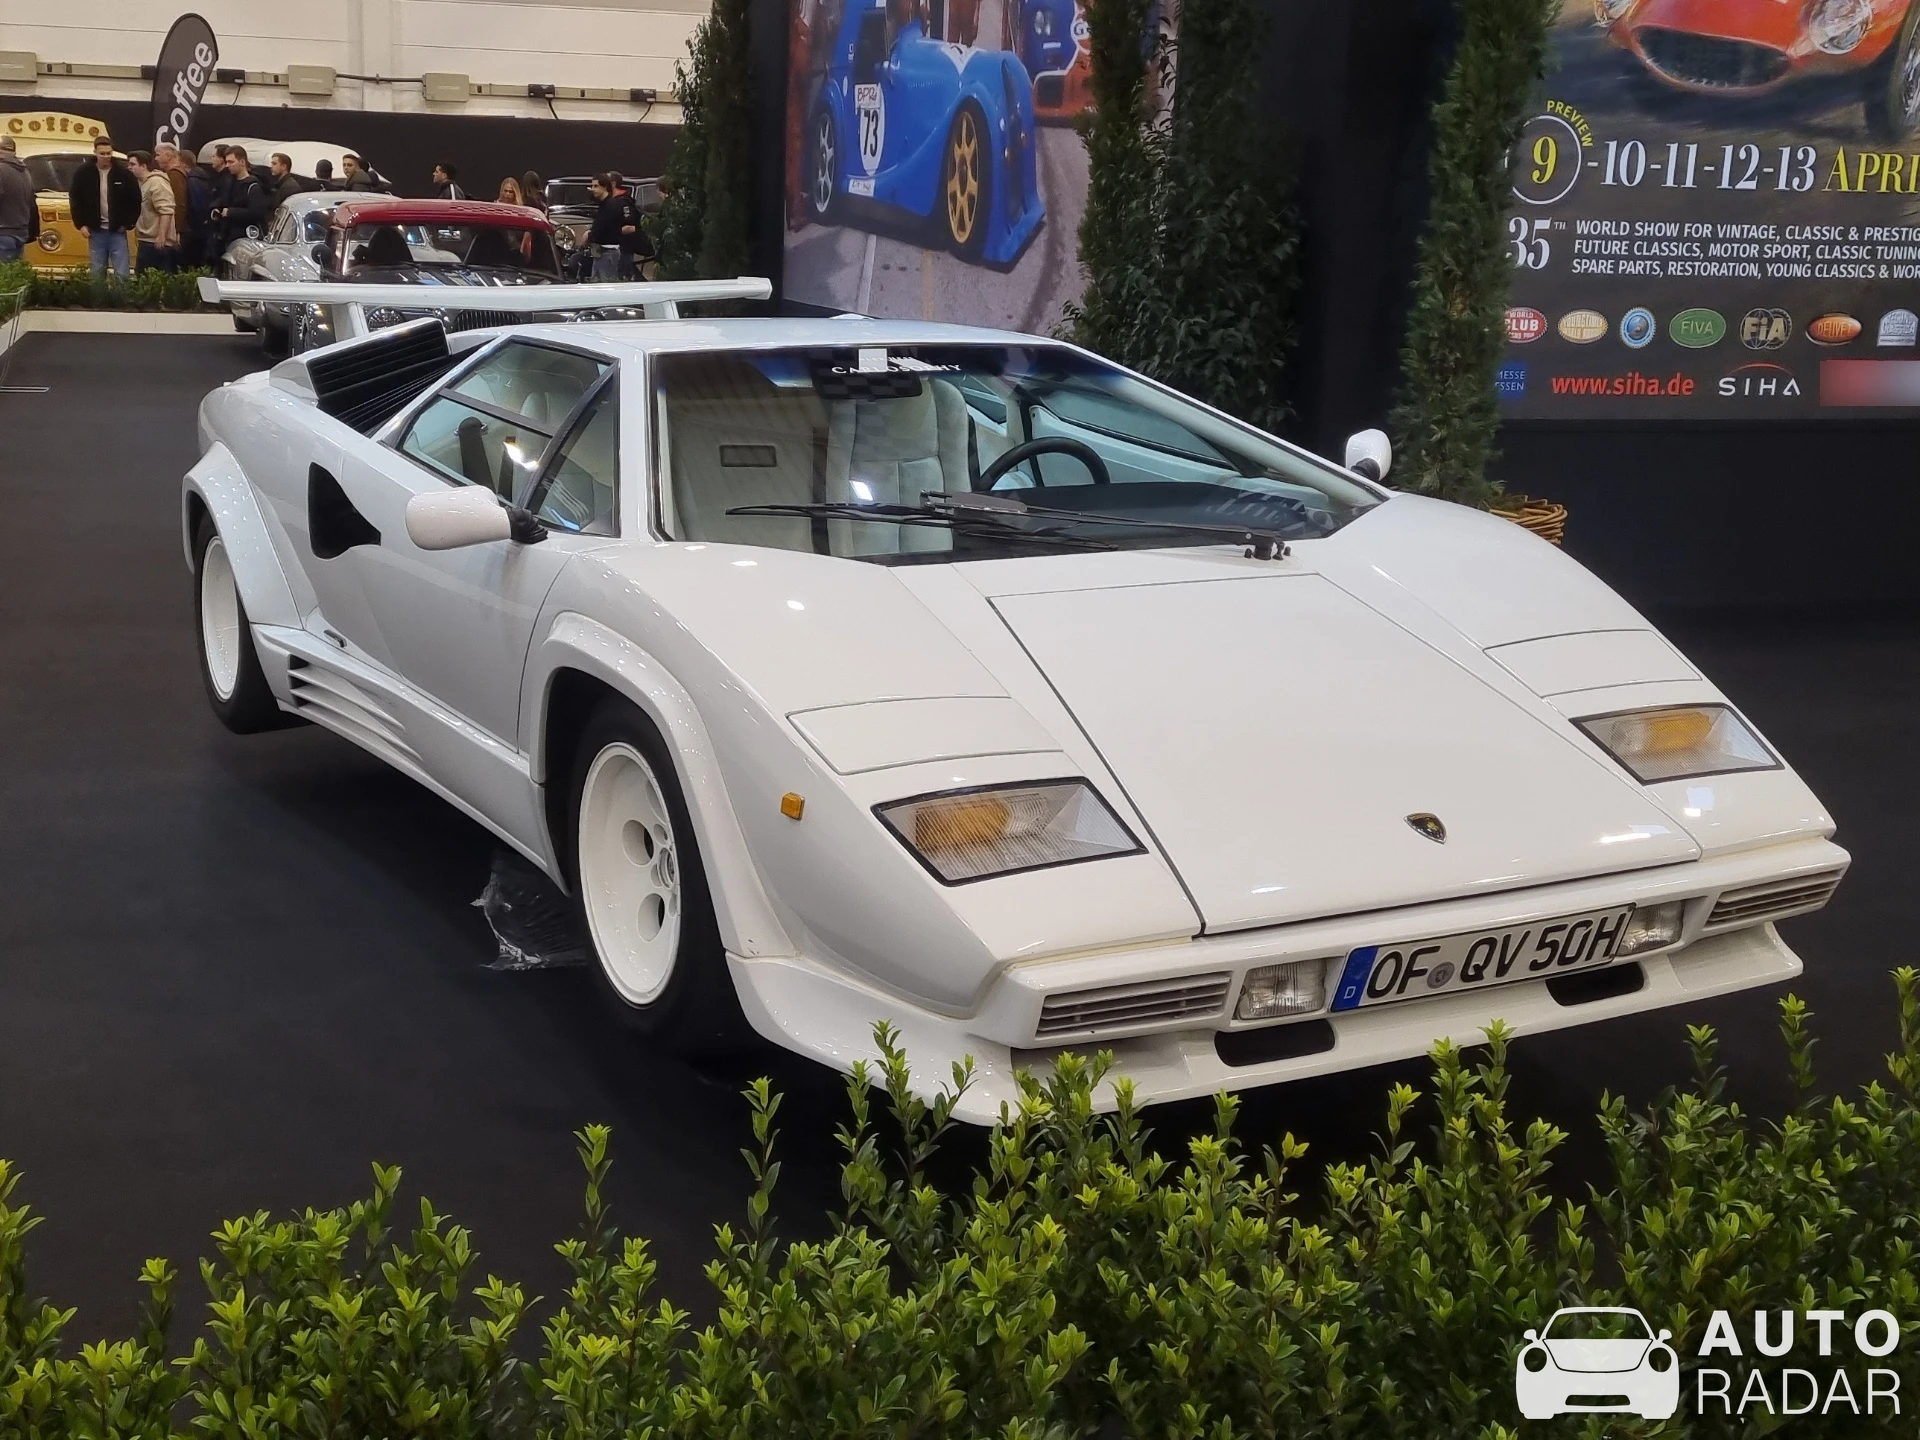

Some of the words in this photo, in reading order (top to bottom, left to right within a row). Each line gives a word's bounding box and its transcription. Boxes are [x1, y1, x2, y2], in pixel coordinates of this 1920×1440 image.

[156, 42, 213, 149] Coffee
[7, 116, 100, 138] Coffee
[863, 109, 879, 157] 73
[1546, 100, 1593, 147] PREVIEW
[1531, 136, 1557, 184] 9
[1576, 220, 1630, 236] WORLD
[1634, 222, 1680, 237] SHOW
[1683, 223, 1712, 238] FOR
[1717, 224, 1780, 242] VINTAGE,
[1785, 225, 1844, 241] CLASSIC
[1848, 227, 1859, 241] &
[1505, 217, 1552, 270] 35
[1574, 239, 1630, 255] FUTURE
[1633, 241, 1704, 260] CLASSICS,
[1708, 243, 1759, 258] MOTOR
[1763, 244, 1811, 261] SPORT,
[1815, 245, 1872, 260] CLASSIC
[1571, 258, 1615, 274] SPARE
[1618, 260, 1664, 278] PARTS,
[1667, 261, 1761, 280] RESTORATION,
[1766, 263, 1811, 278] YOUNG
[1815, 264, 1876, 279] CLASSICS
[1878, 265, 1890, 279] &
[1680, 320, 1714, 335] FIVA
[1552, 372, 1694, 396] www.siha.de
[1718, 377, 1801, 396] SIHA
[1343, 986, 1356, 999] D
[1367, 945, 1441, 998] OF
[1460, 930, 1531, 983] QV
[1529, 913, 1627, 971] 50H
